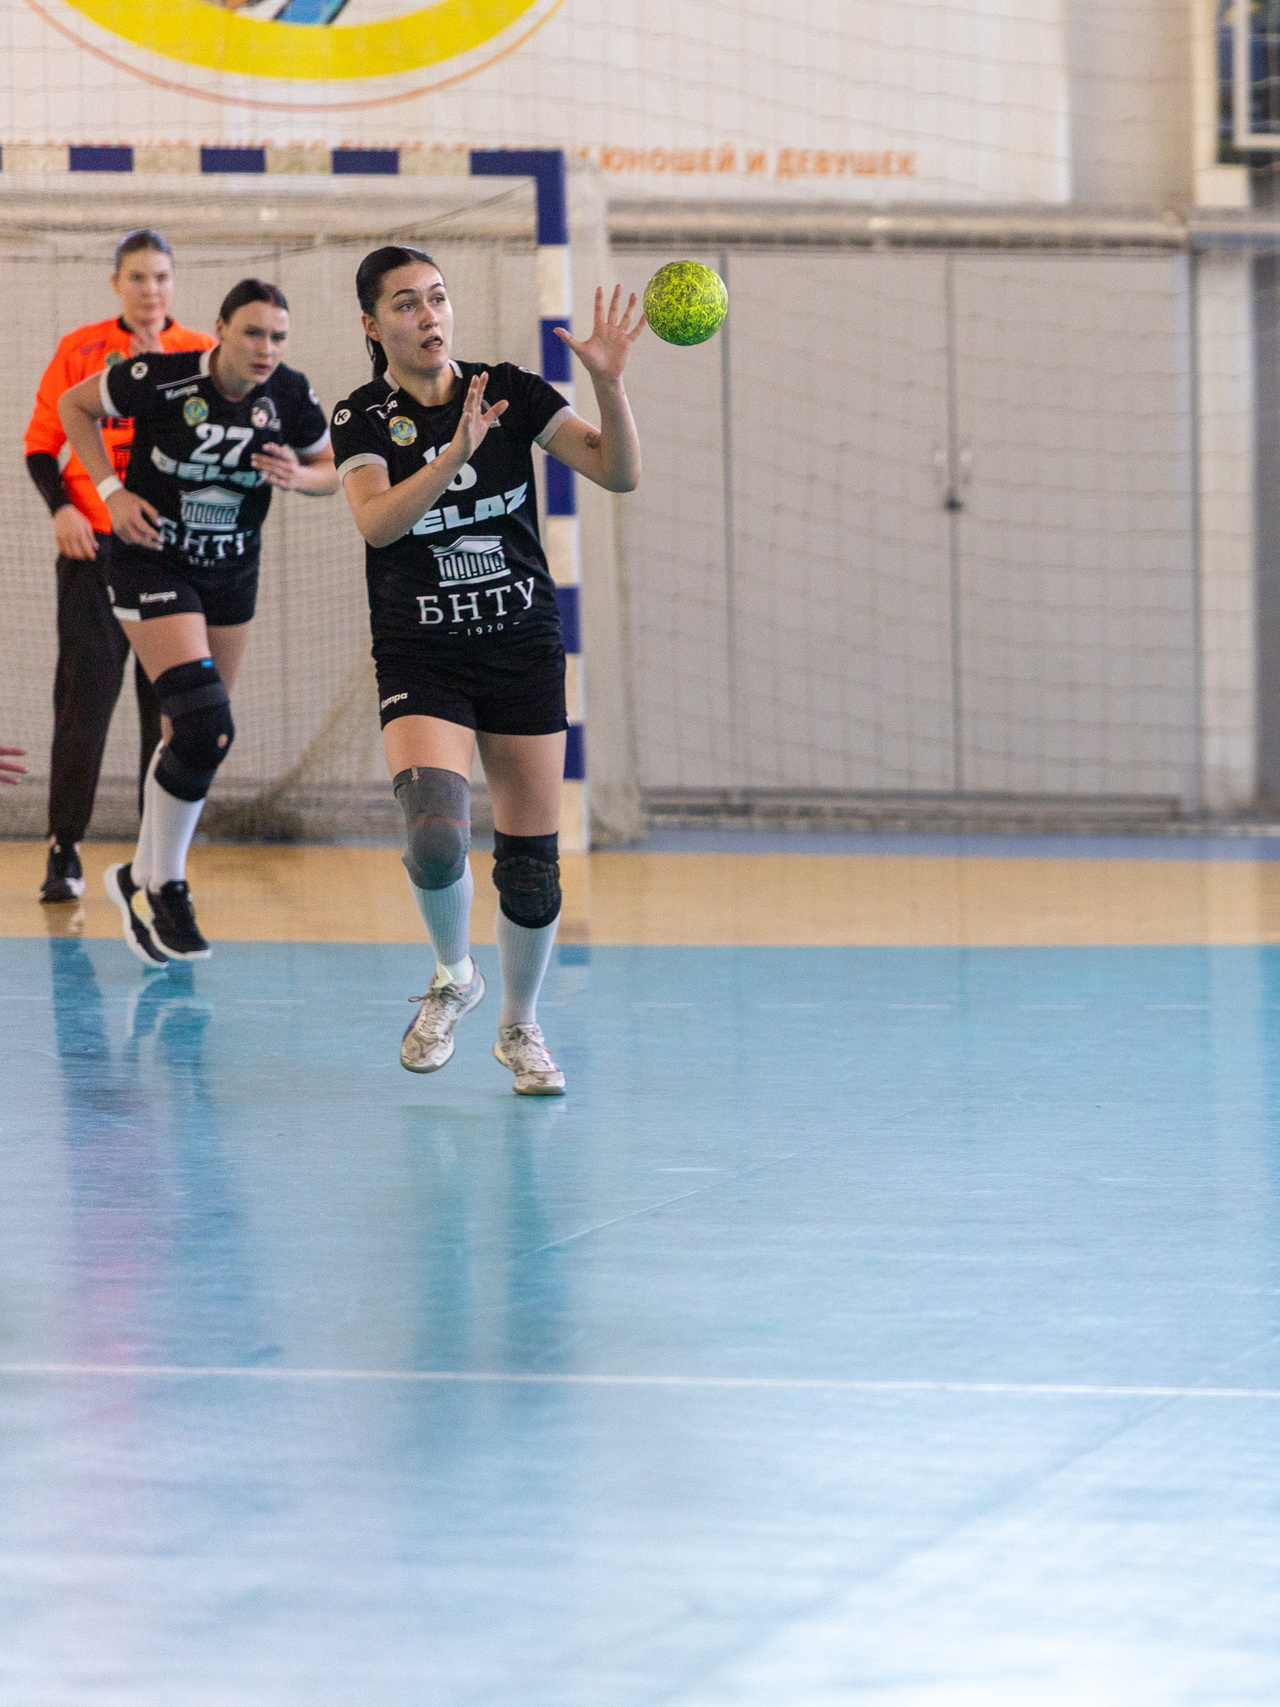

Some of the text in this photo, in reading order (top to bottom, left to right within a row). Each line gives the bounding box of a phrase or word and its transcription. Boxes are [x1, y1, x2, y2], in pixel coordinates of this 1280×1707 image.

[599, 143, 736, 173] ЮНОШЕЙ
[747, 149, 767, 173] И
[775, 148, 917, 179] ДЕВУШЕК
[190, 423, 254, 467] 27
[406, 482, 528, 536] ELAZ
[416, 577, 535, 625] БНТУ
[467, 622, 504, 636] 1920
